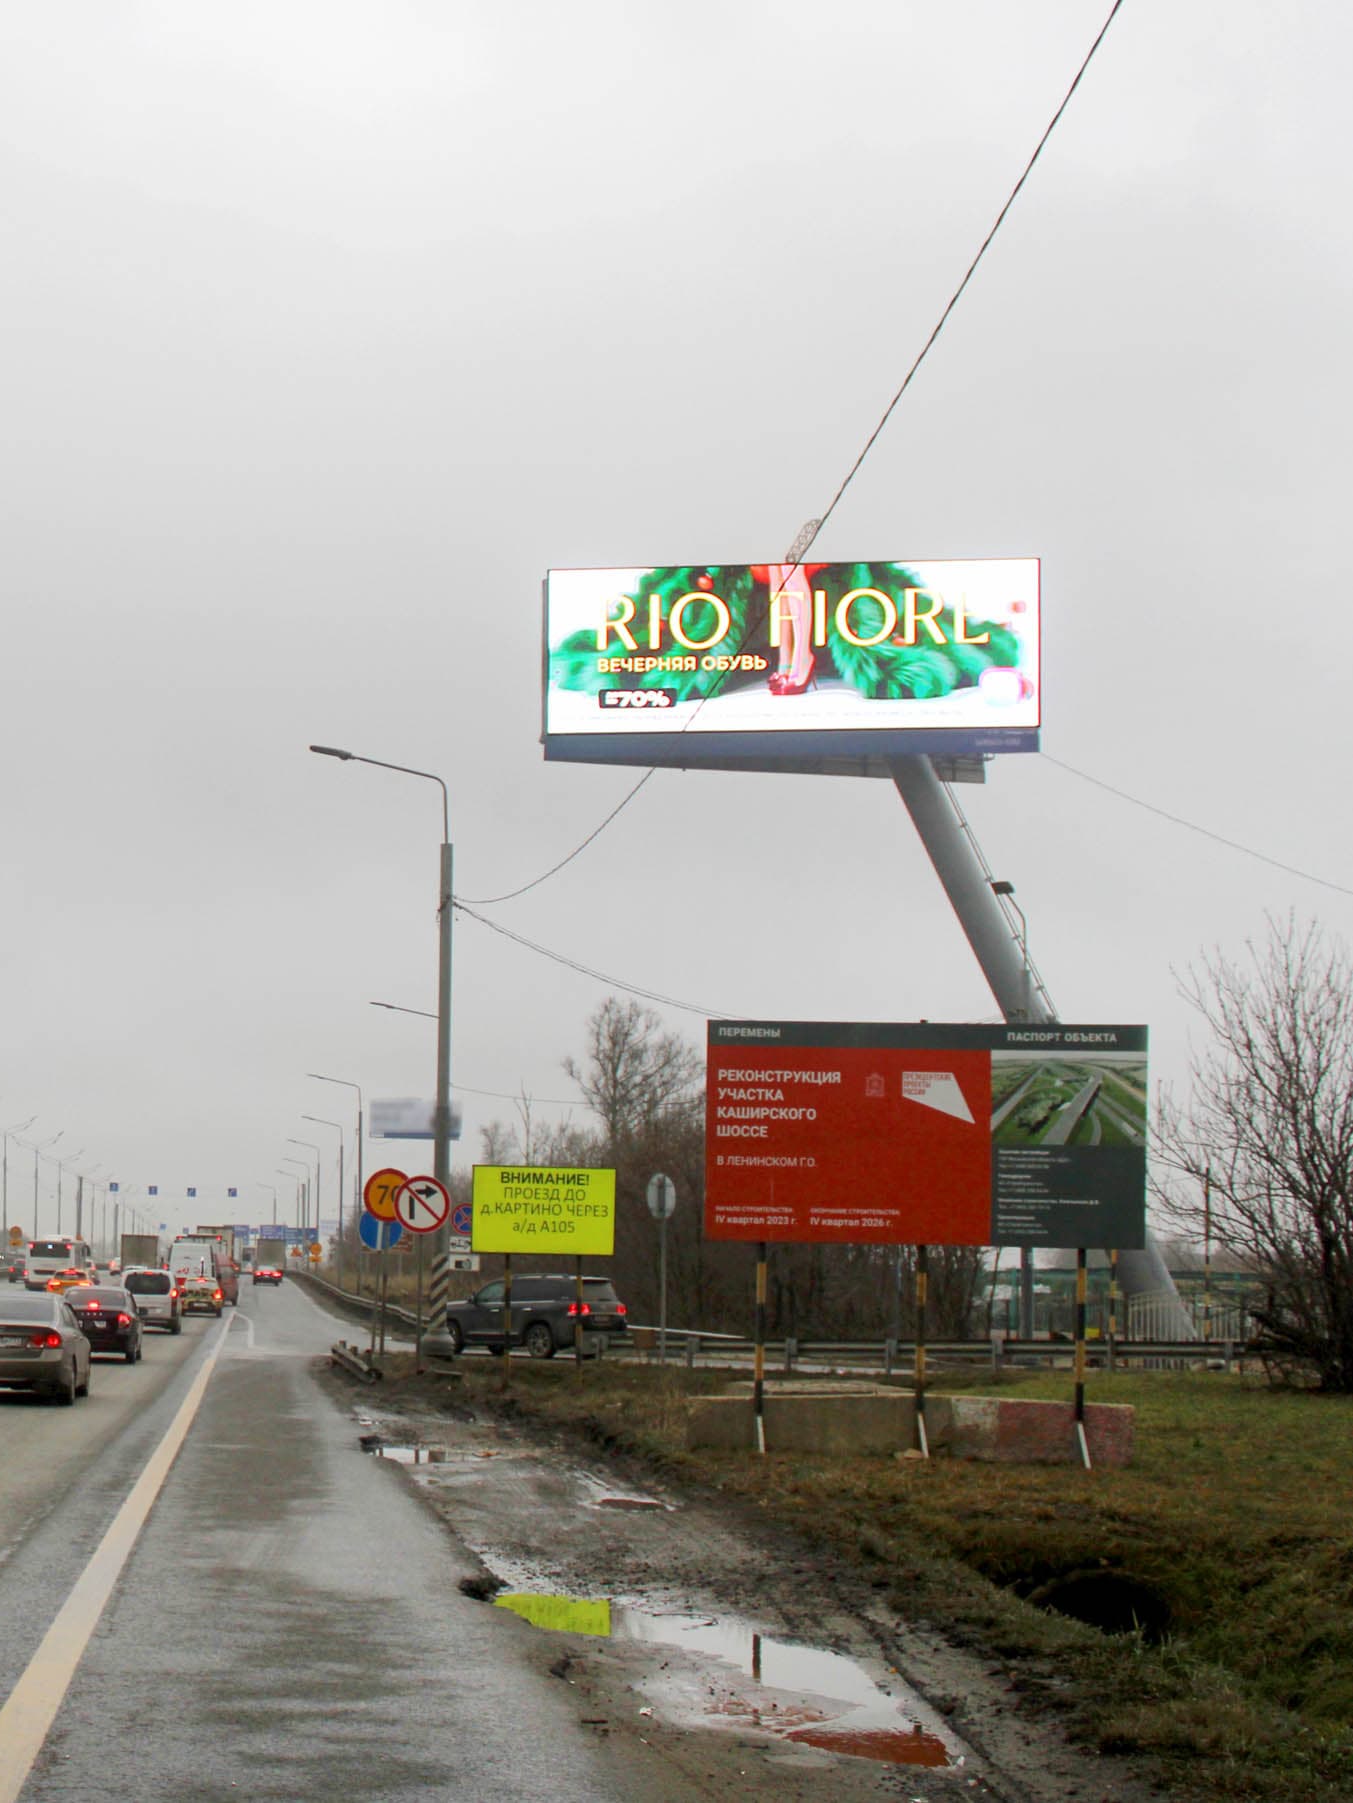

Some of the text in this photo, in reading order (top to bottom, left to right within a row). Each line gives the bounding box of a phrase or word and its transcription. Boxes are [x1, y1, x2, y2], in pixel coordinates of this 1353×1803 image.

[596, 588, 991, 651] RIO FIORE
[597, 654, 768, 673] ВЕЧЕРНЯЯ ОБУВЬ
[719, 1028, 780, 1038] ПЕРЕМЕНЫ
[1007, 1031, 1117, 1043] ПАСПОРТ ОБЪЕКТА
[718, 1069, 841, 1084] РЕКОНСТРУКЦИЯ
[717, 1087, 784, 1101] УЧАСТКА
[717, 1106, 817, 1121] КАШИРСКОГО
[716, 1124, 768, 1138] ШОССЕ
[717, 1156, 817, 1167] В ЛЕНИНСКОМ Г.О.
[500, 1171, 590, 1186] ВНИМАНИЕ!
[503, 1187, 585, 1203] ПРОЕЗД ДО
[480, 1203, 609, 1217] д.КАРТИНО ЧЕРЕЗ
[512, 1219, 575, 1234] а/д А105
[727, 1216, 765, 1225] квартал
[810, 1217, 818, 1225] IV
[821, 1218, 860, 1227] квартал
